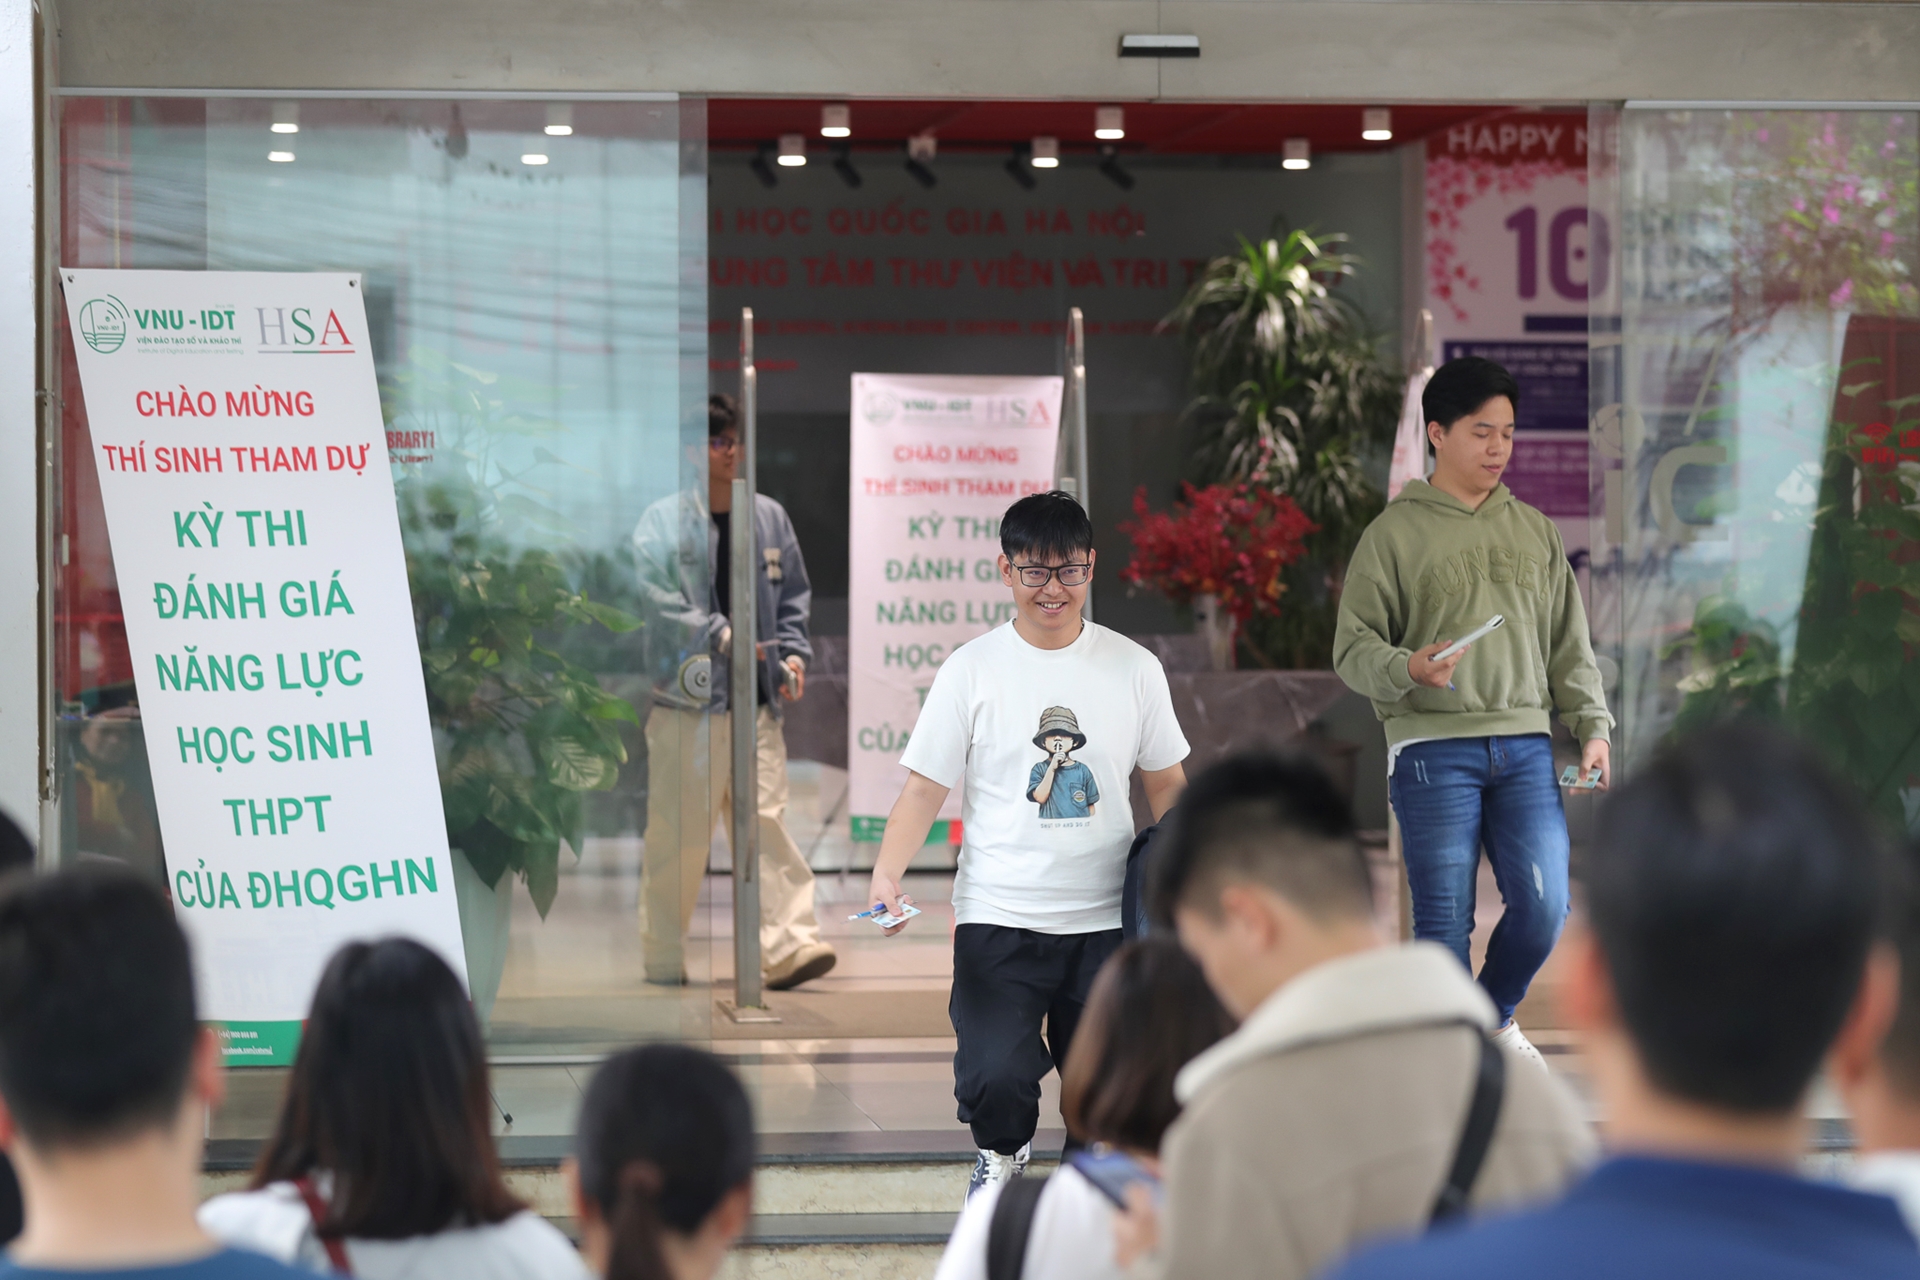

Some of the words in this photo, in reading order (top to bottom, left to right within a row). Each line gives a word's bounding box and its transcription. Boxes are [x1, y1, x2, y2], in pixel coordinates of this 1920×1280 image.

[1448, 124, 1563, 155] HAPPY
[736, 207, 811, 239] HỌC
[826, 197, 931, 236] QUỐC
[945, 207, 1006, 236] GIA
[708, 256, 789, 288] UNG
[971, 249, 1054, 294] VIỆN
[1109, 257, 1169, 288] TRI
[136, 335, 153, 345] VIỆN
[254, 307, 354, 346] HSA
[135, 385, 217, 418] CHÀO
[225, 385, 316, 418] MỪNG
[102, 440, 148, 473] THÍ
[154, 446, 224, 474] SINH
[230, 445, 319, 473] THAM
[326, 442, 371, 477] DỰ
[386, 430, 435, 449] BRARY1
[893, 441, 952, 464] CHÀO
[901, 479, 950, 496] SINH
[952, 478, 1015, 496] THAM
[173, 501, 224, 549] KỲ
[236, 509, 309, 547] THI
[885, 553, 966, 583] ĐÁNH
[153, 572, 268, 620] ĐÁNH
[279, 570, 355, 618] GIÁ
[154, 644, 266, 692] NĂNG
[276, 648, 364, 697] LỰC
[883, 643, 944, 673] HỌC
[176, 725, 256, 773] HỌC
[267, 719, 373, 763] SINH
[223, 794, 332, 837] THPT
[175, 857, 242, 909] CỦA
[247, 856, 439, 910] ĐHQGHN
